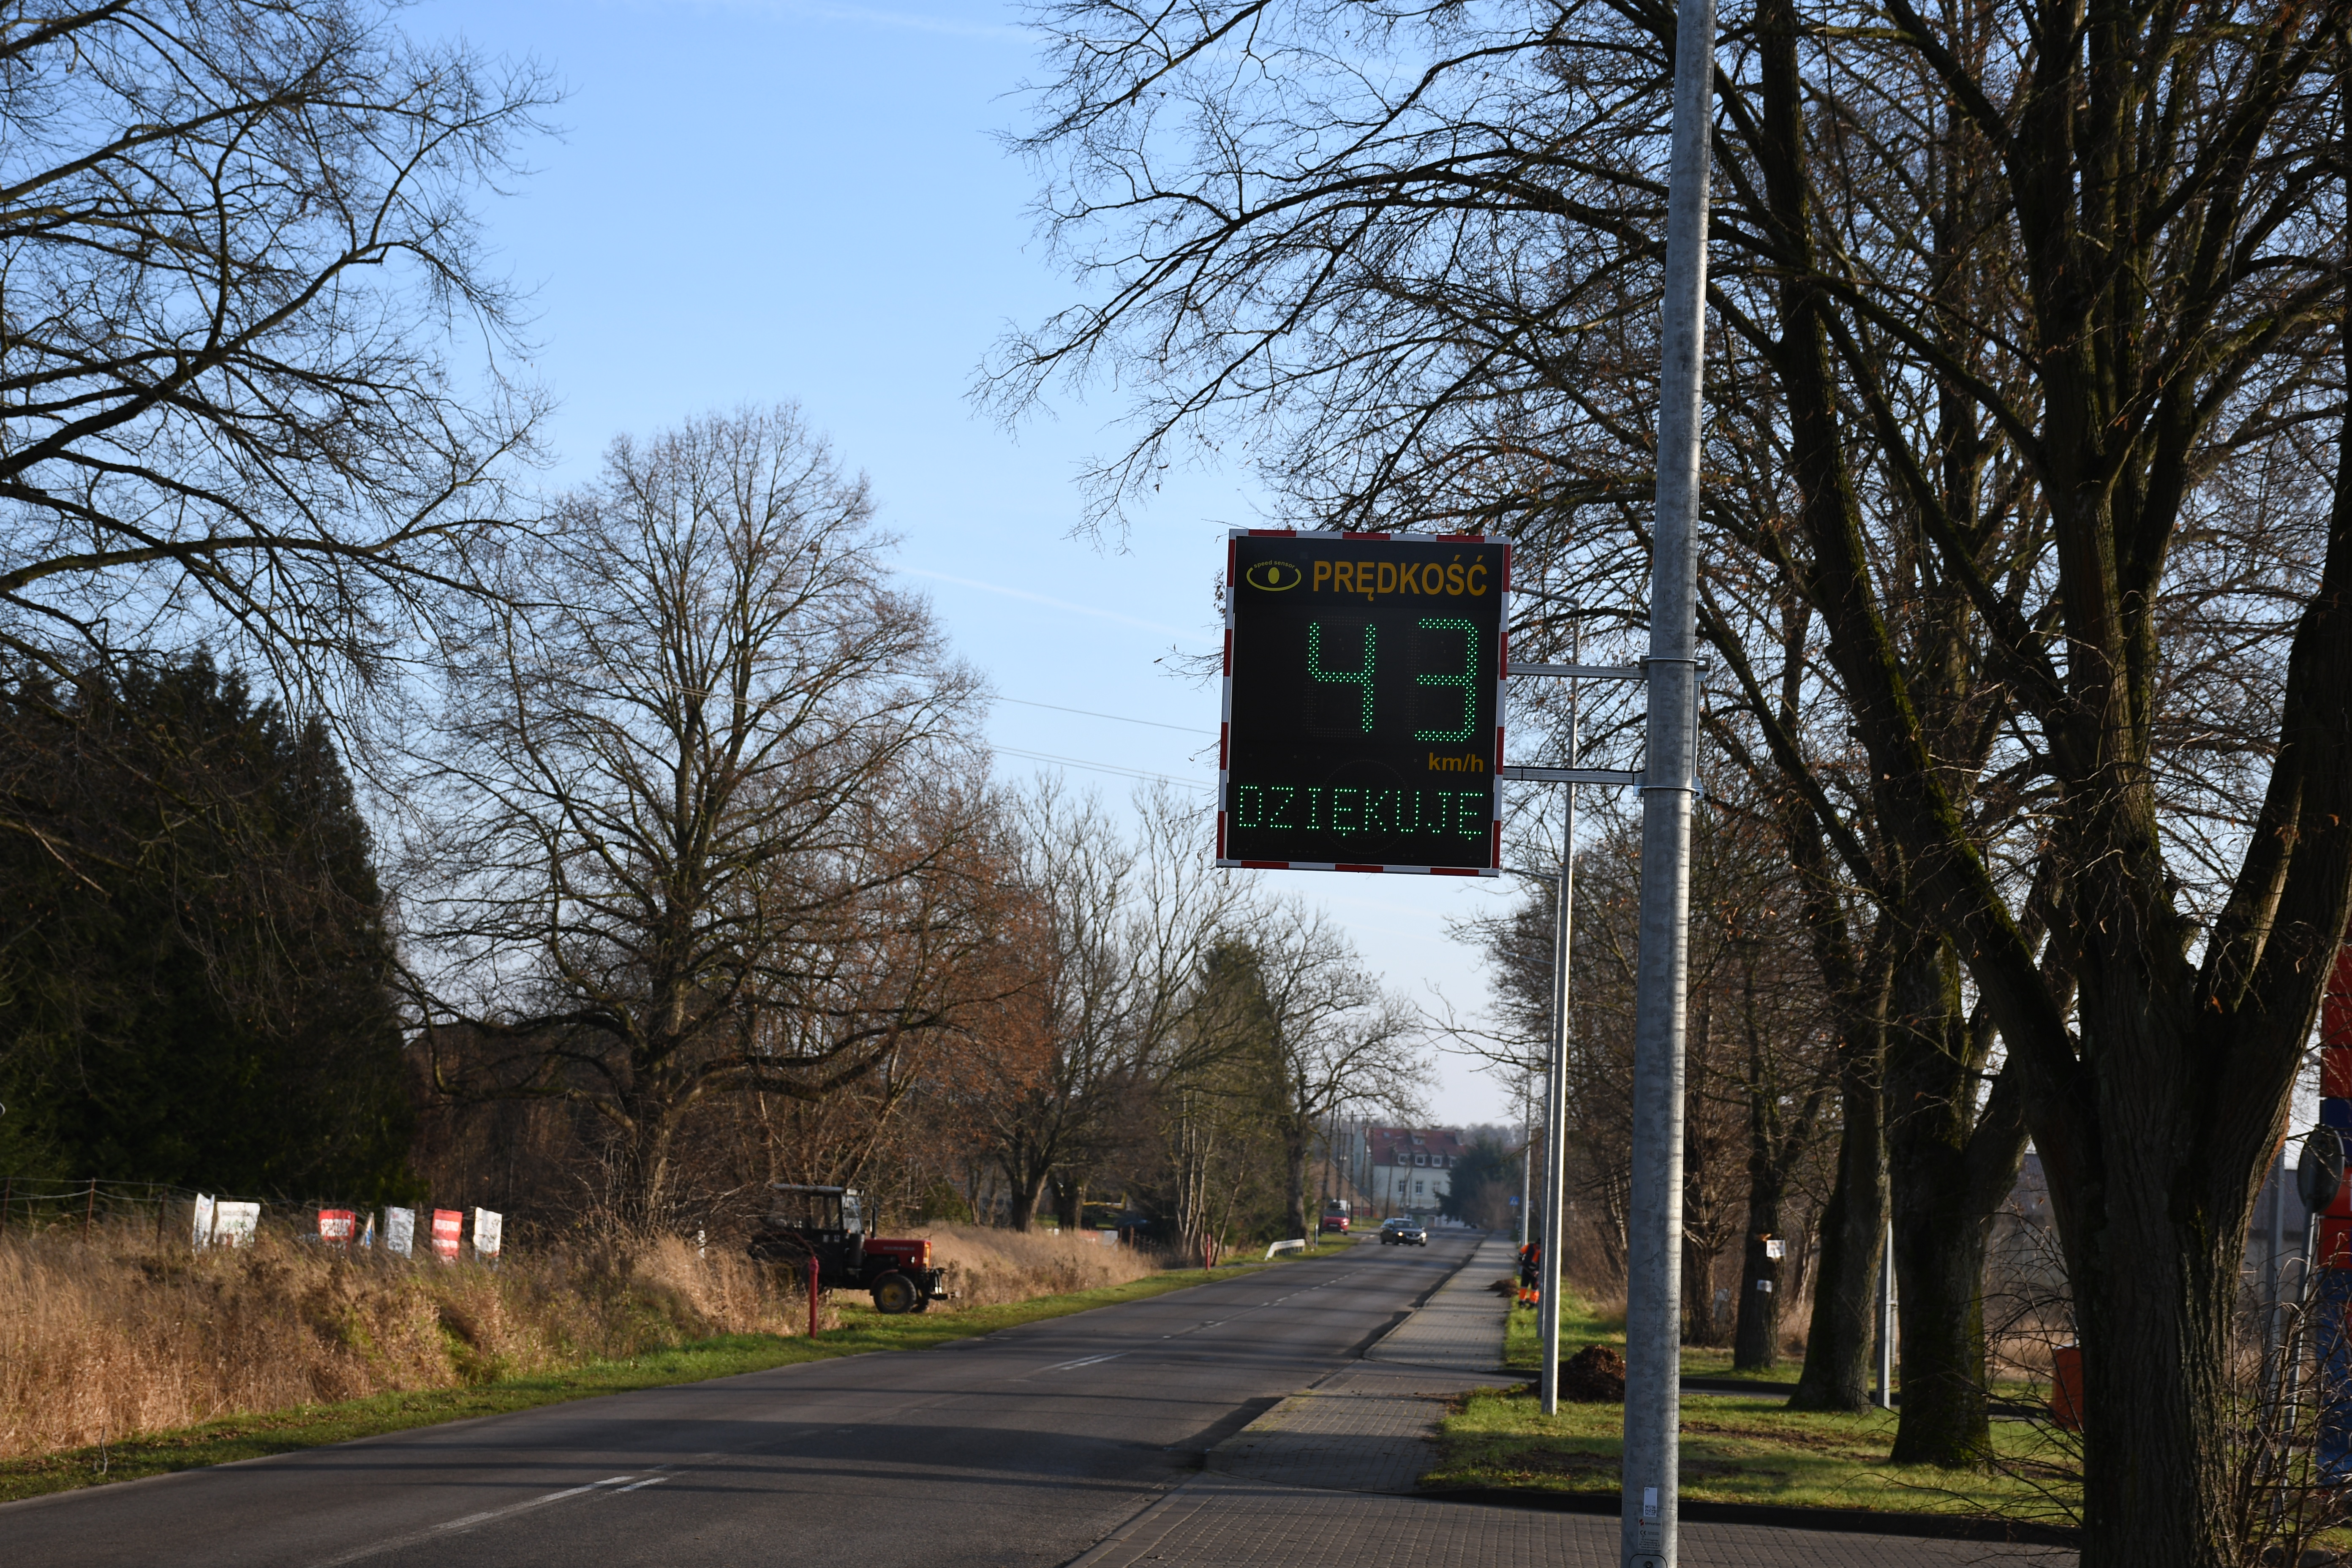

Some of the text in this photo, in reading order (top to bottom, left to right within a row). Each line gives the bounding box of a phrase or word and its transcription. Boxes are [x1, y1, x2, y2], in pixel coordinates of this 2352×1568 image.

[1254, 560, 1295, 569] speed sensor
[1313, 555, 1487, 601] PRĘDKOŚĆ
[1308, 618, 1478, 742] 43
[1429, 752, 1484, 773] km/h
[1239, 785, 1483, 841] DZIĘKUJĘ
